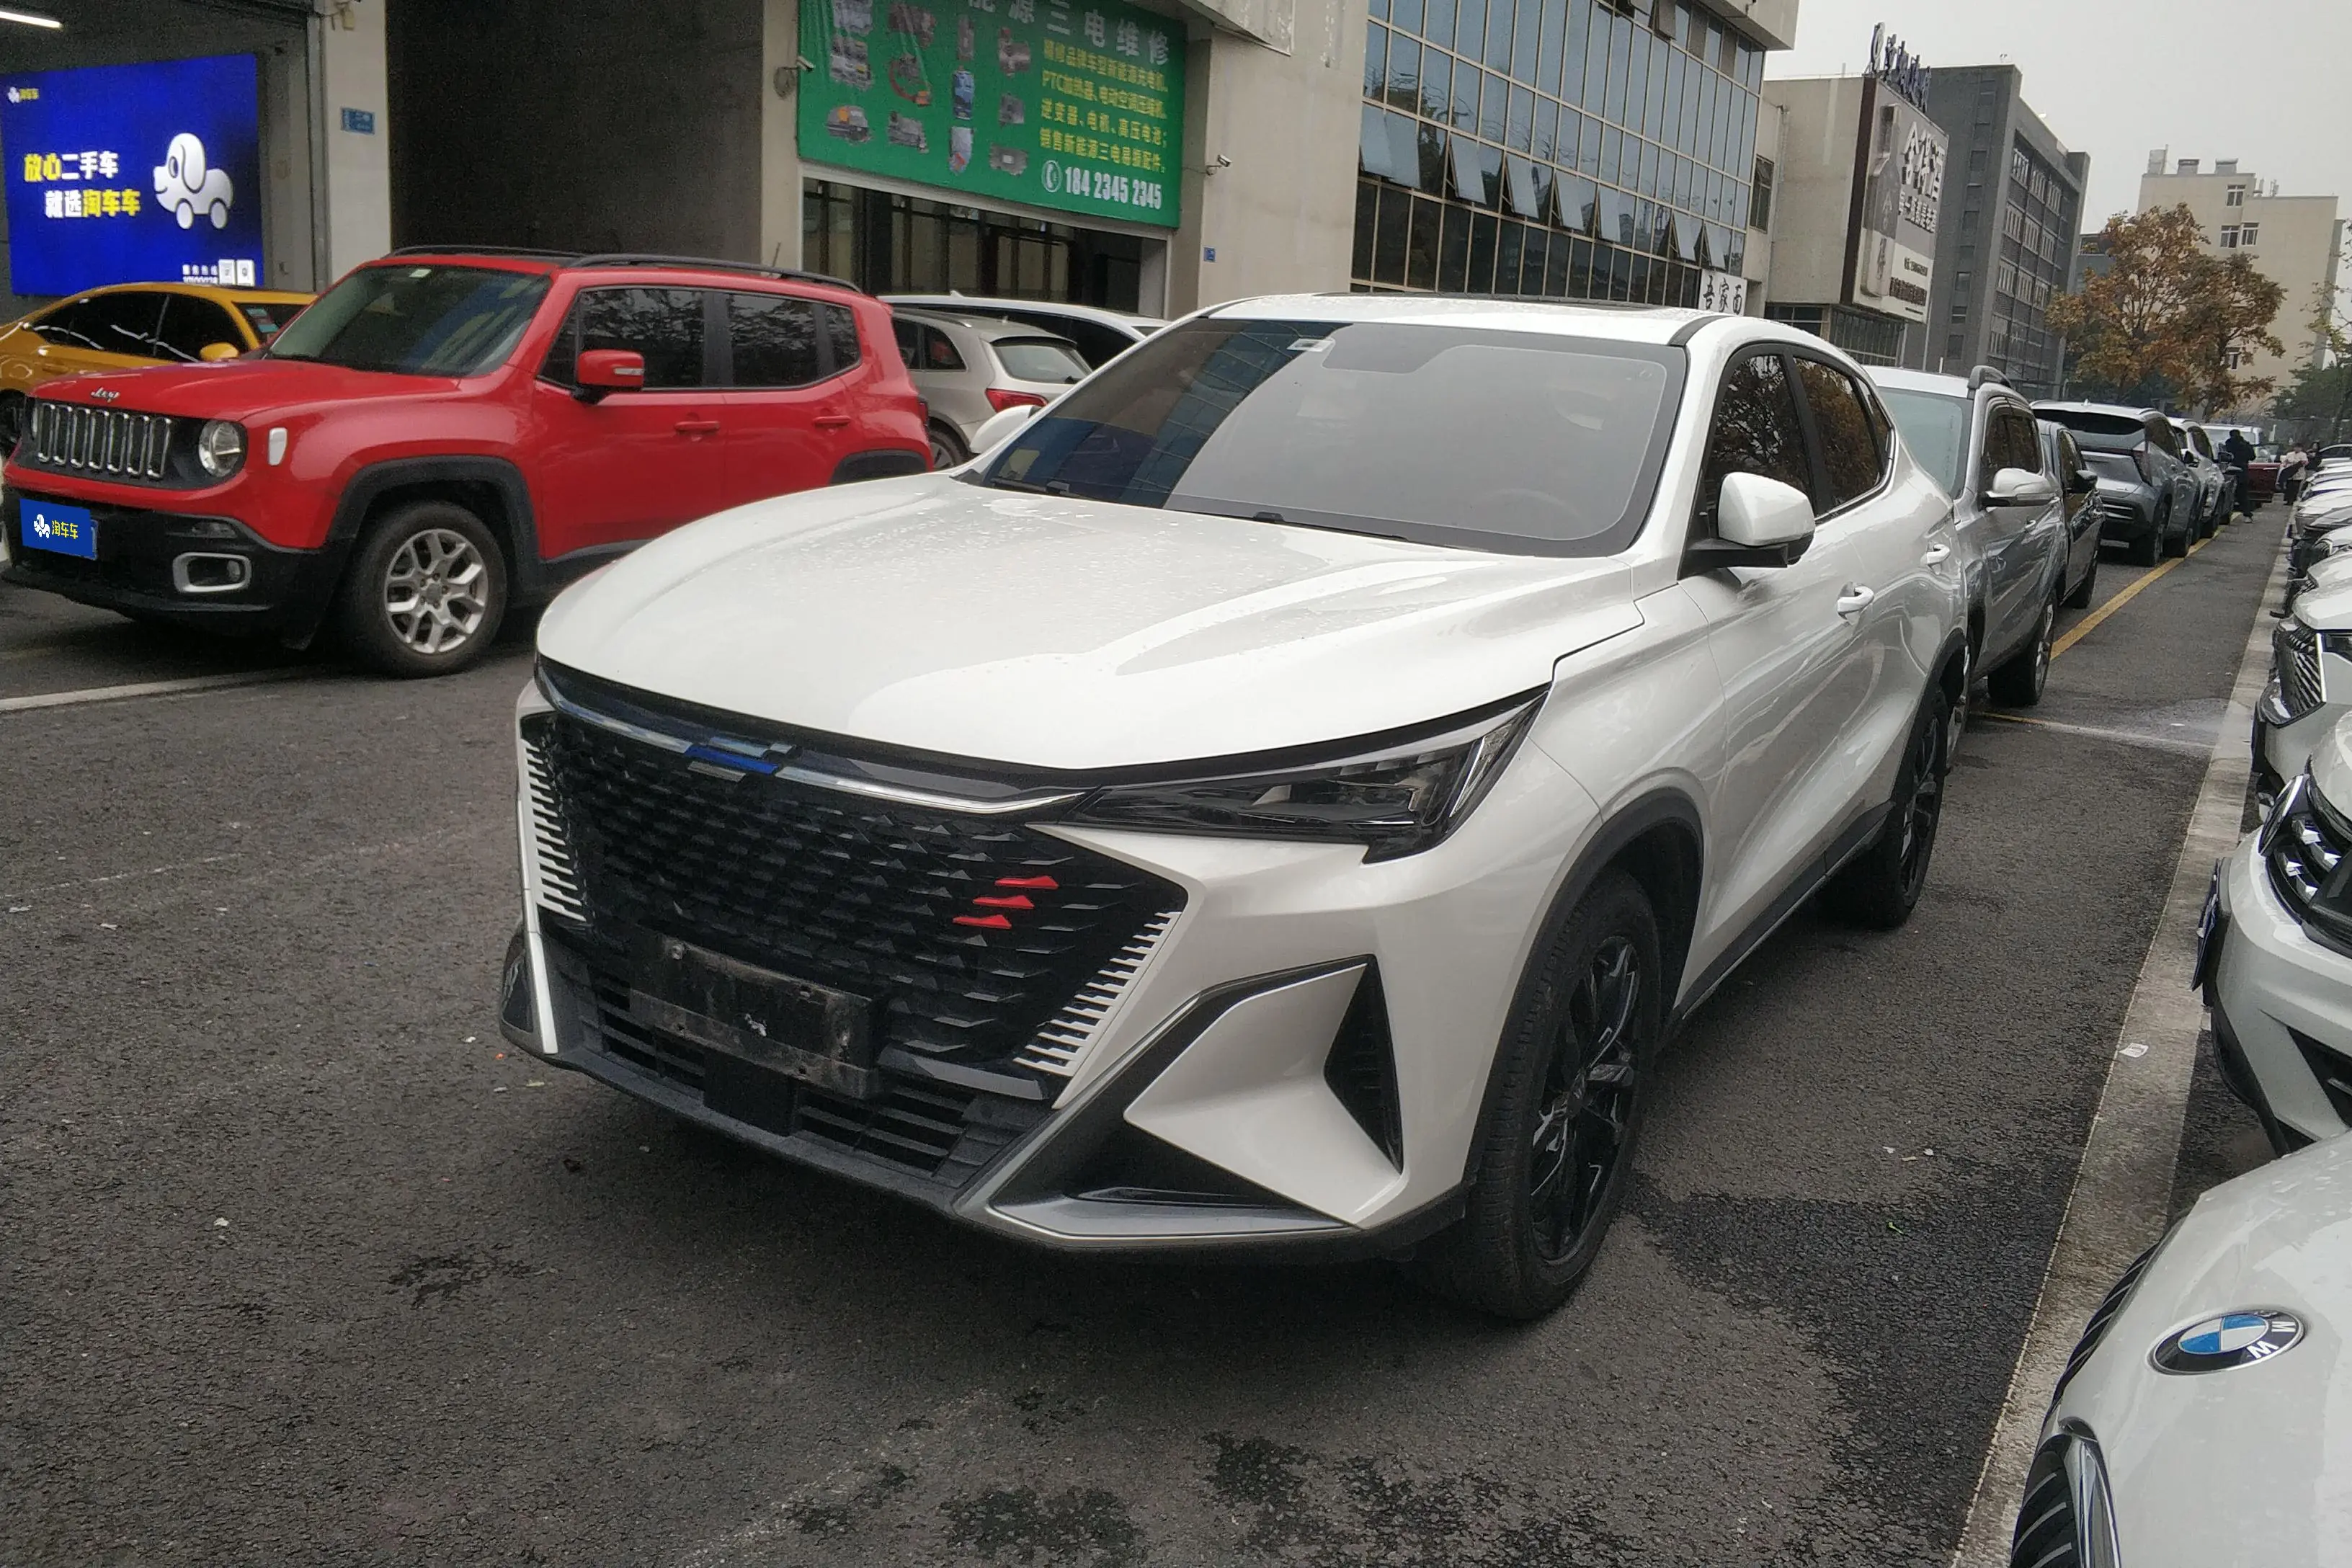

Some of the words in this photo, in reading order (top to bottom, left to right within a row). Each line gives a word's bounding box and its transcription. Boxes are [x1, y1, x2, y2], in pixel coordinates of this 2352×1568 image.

[24, 151, 118, 182] 放心二手车
[1065, 166, 1090, 196] 184
[1094, 172, 1128, 203] 2345
[1132, 179, 1162, 210] 2345
[45, 189, 140, 218] 就选淘车车
[91, 387, 120, 403] Jeep
